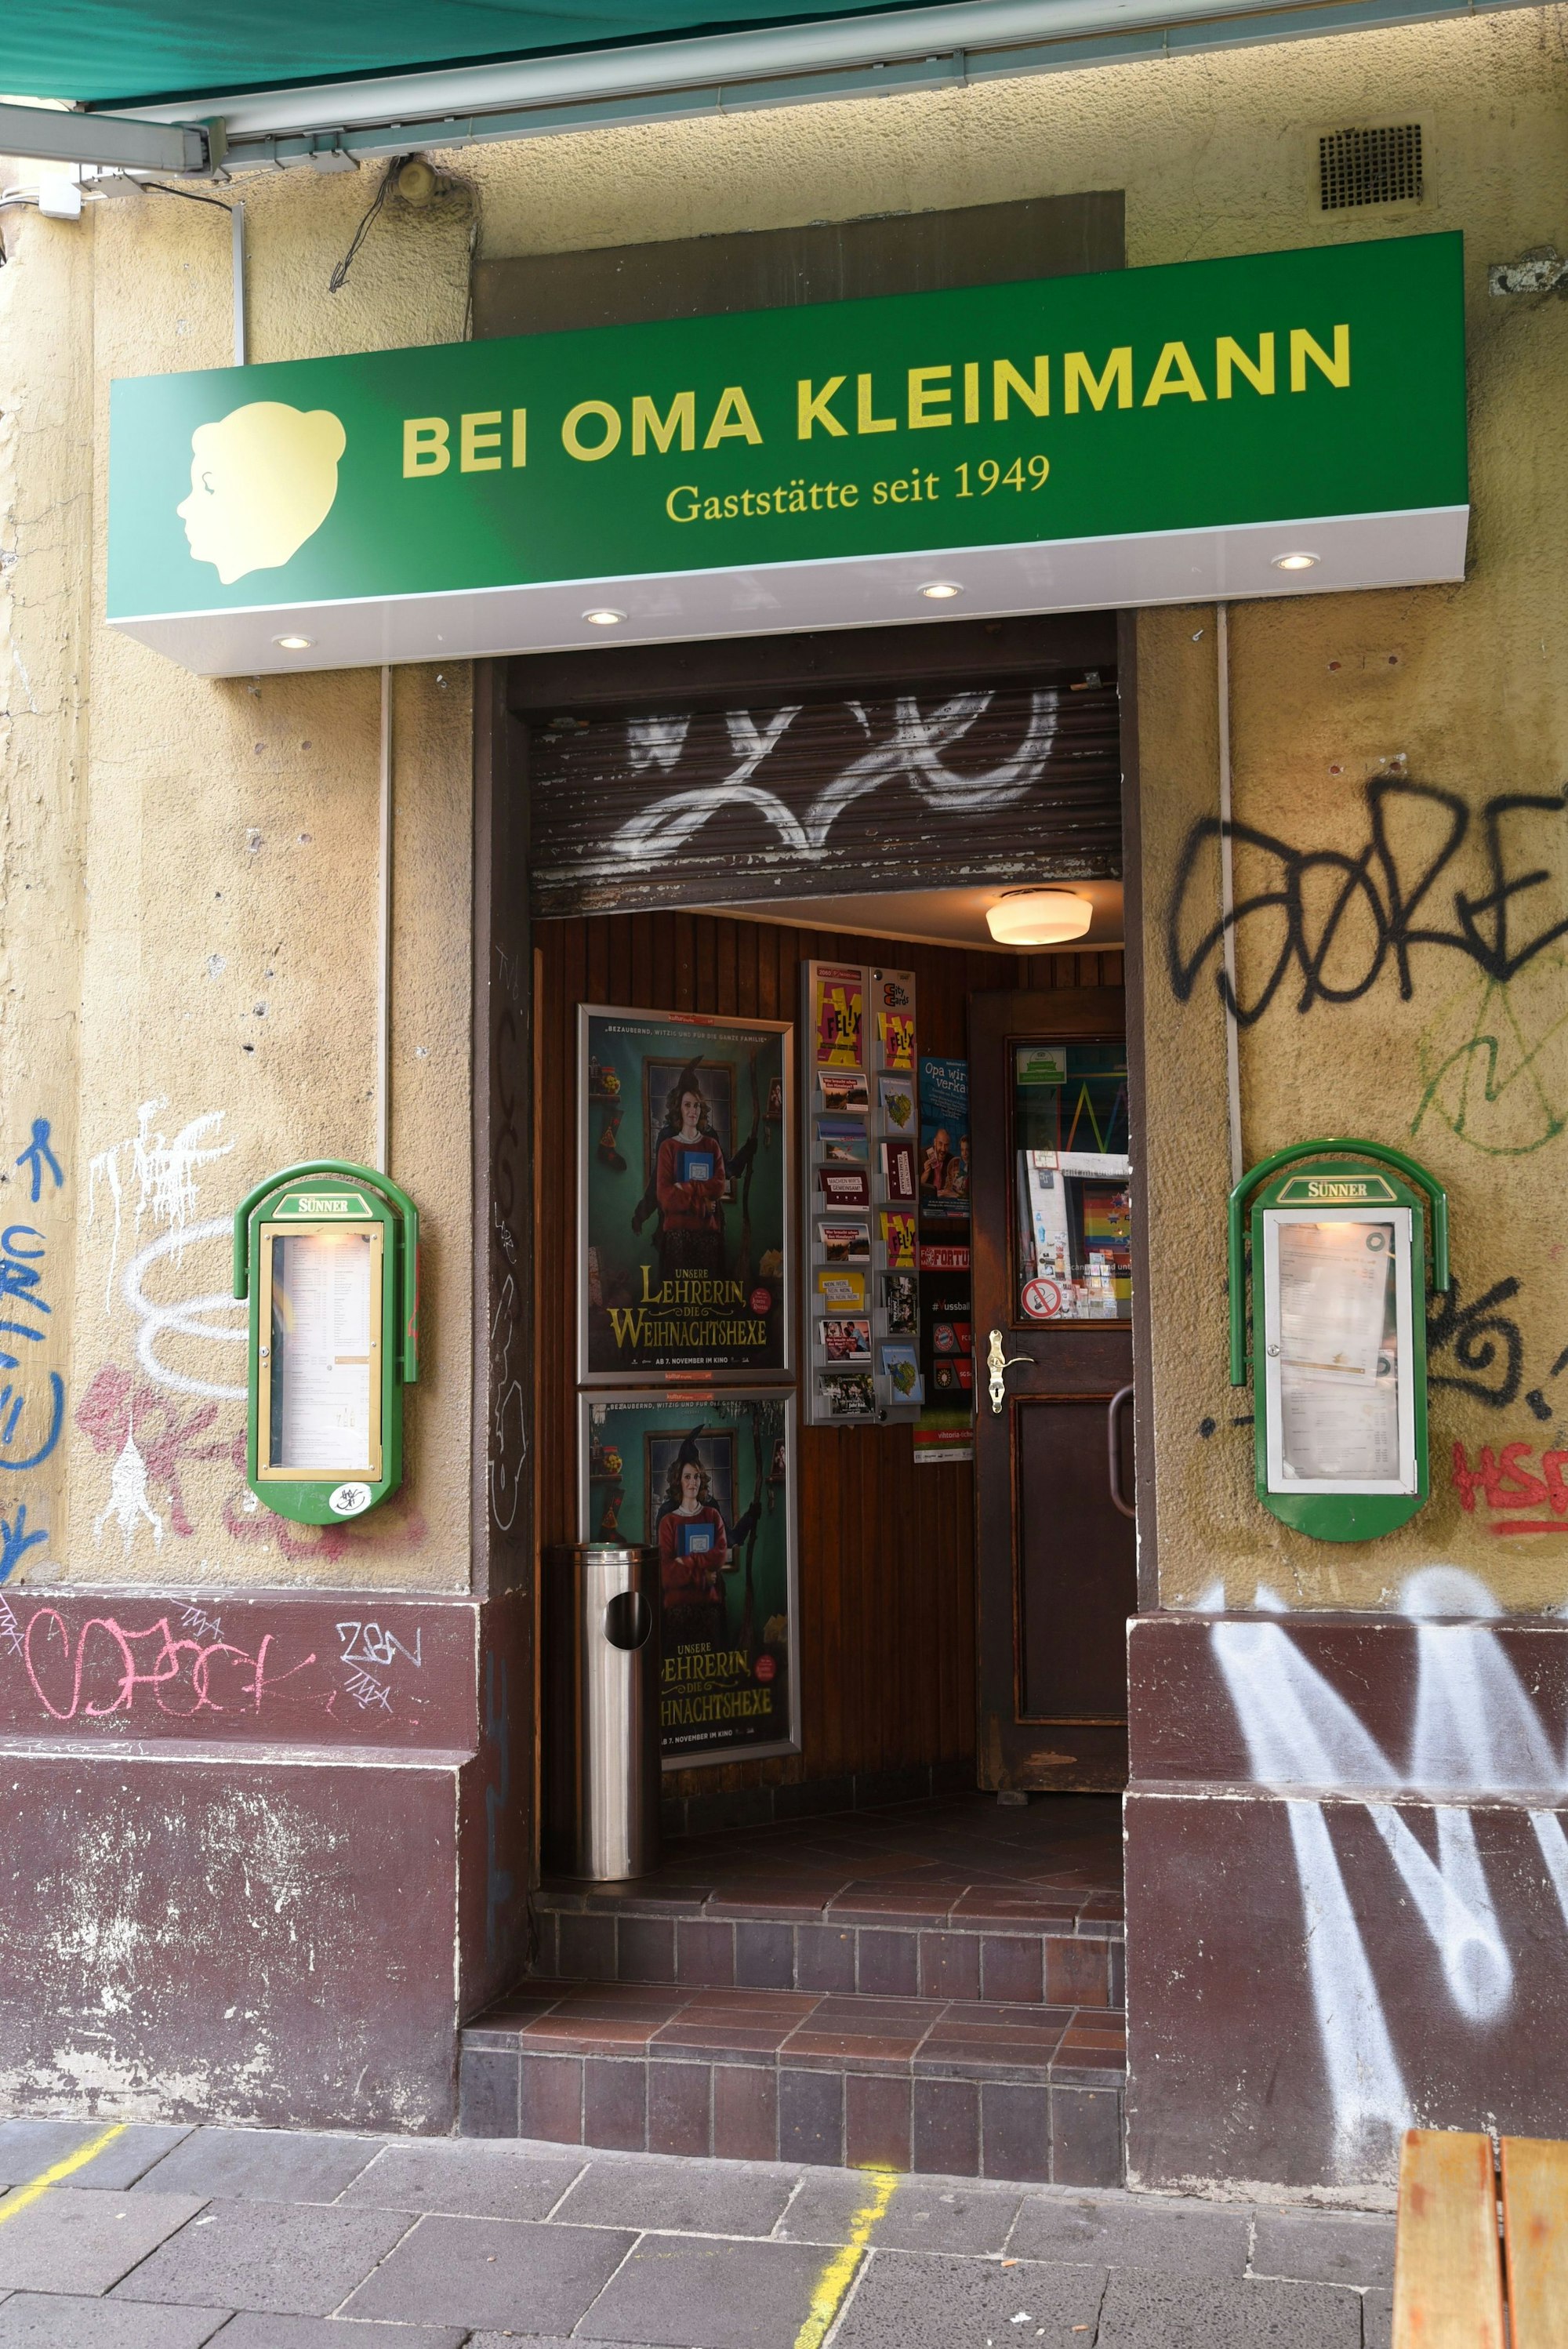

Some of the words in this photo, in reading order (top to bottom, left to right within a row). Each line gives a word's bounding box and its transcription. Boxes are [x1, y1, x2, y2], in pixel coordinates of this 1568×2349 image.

[402, 408, 527, 479] BEI
[561, 386, 764, 462] OMA
[797, 324, 1351, 440] KLEINMANN
[666, 479, 858, 523] Gaststätte
[873, 468, 940, 505] seit
[955, 455, 1051, 498] 1949
[884, 983, 905, 997] City
[884, 995, 909, 1007] Cards
[925, 1062, 946, 1079] Opa
[948, 1069, 967, 1081] wir
[935, 1077, 968, 1094] verka
[1308, 1180, 1368, 1198] SÜNNER
[298, 1197, 349, 1213] SÜNNER
[934, 1249, 971, 1265] FORTU
[675, 1268, 710, 1279] UNSERE
[640, 1265, 747, 1308] LEHRERIN,
[683, 1306, 700, 1317] DIE
[606, 1308, 768, 1349] WEIHNACHTSHEXE
[677, 1642, 712, 1655] UNSERE
[661, 1650, 752, 1682] EHRERIN,
[687, 1682, 702, 1693] DIE
[661, 1688, 773, 1727] HNACHTSHEXE
[668, 1736, 674, 1745] 7.
[674, 1732, 709, 1744] NOVEMBER
[717, 1729, 734, 1737] KINO
